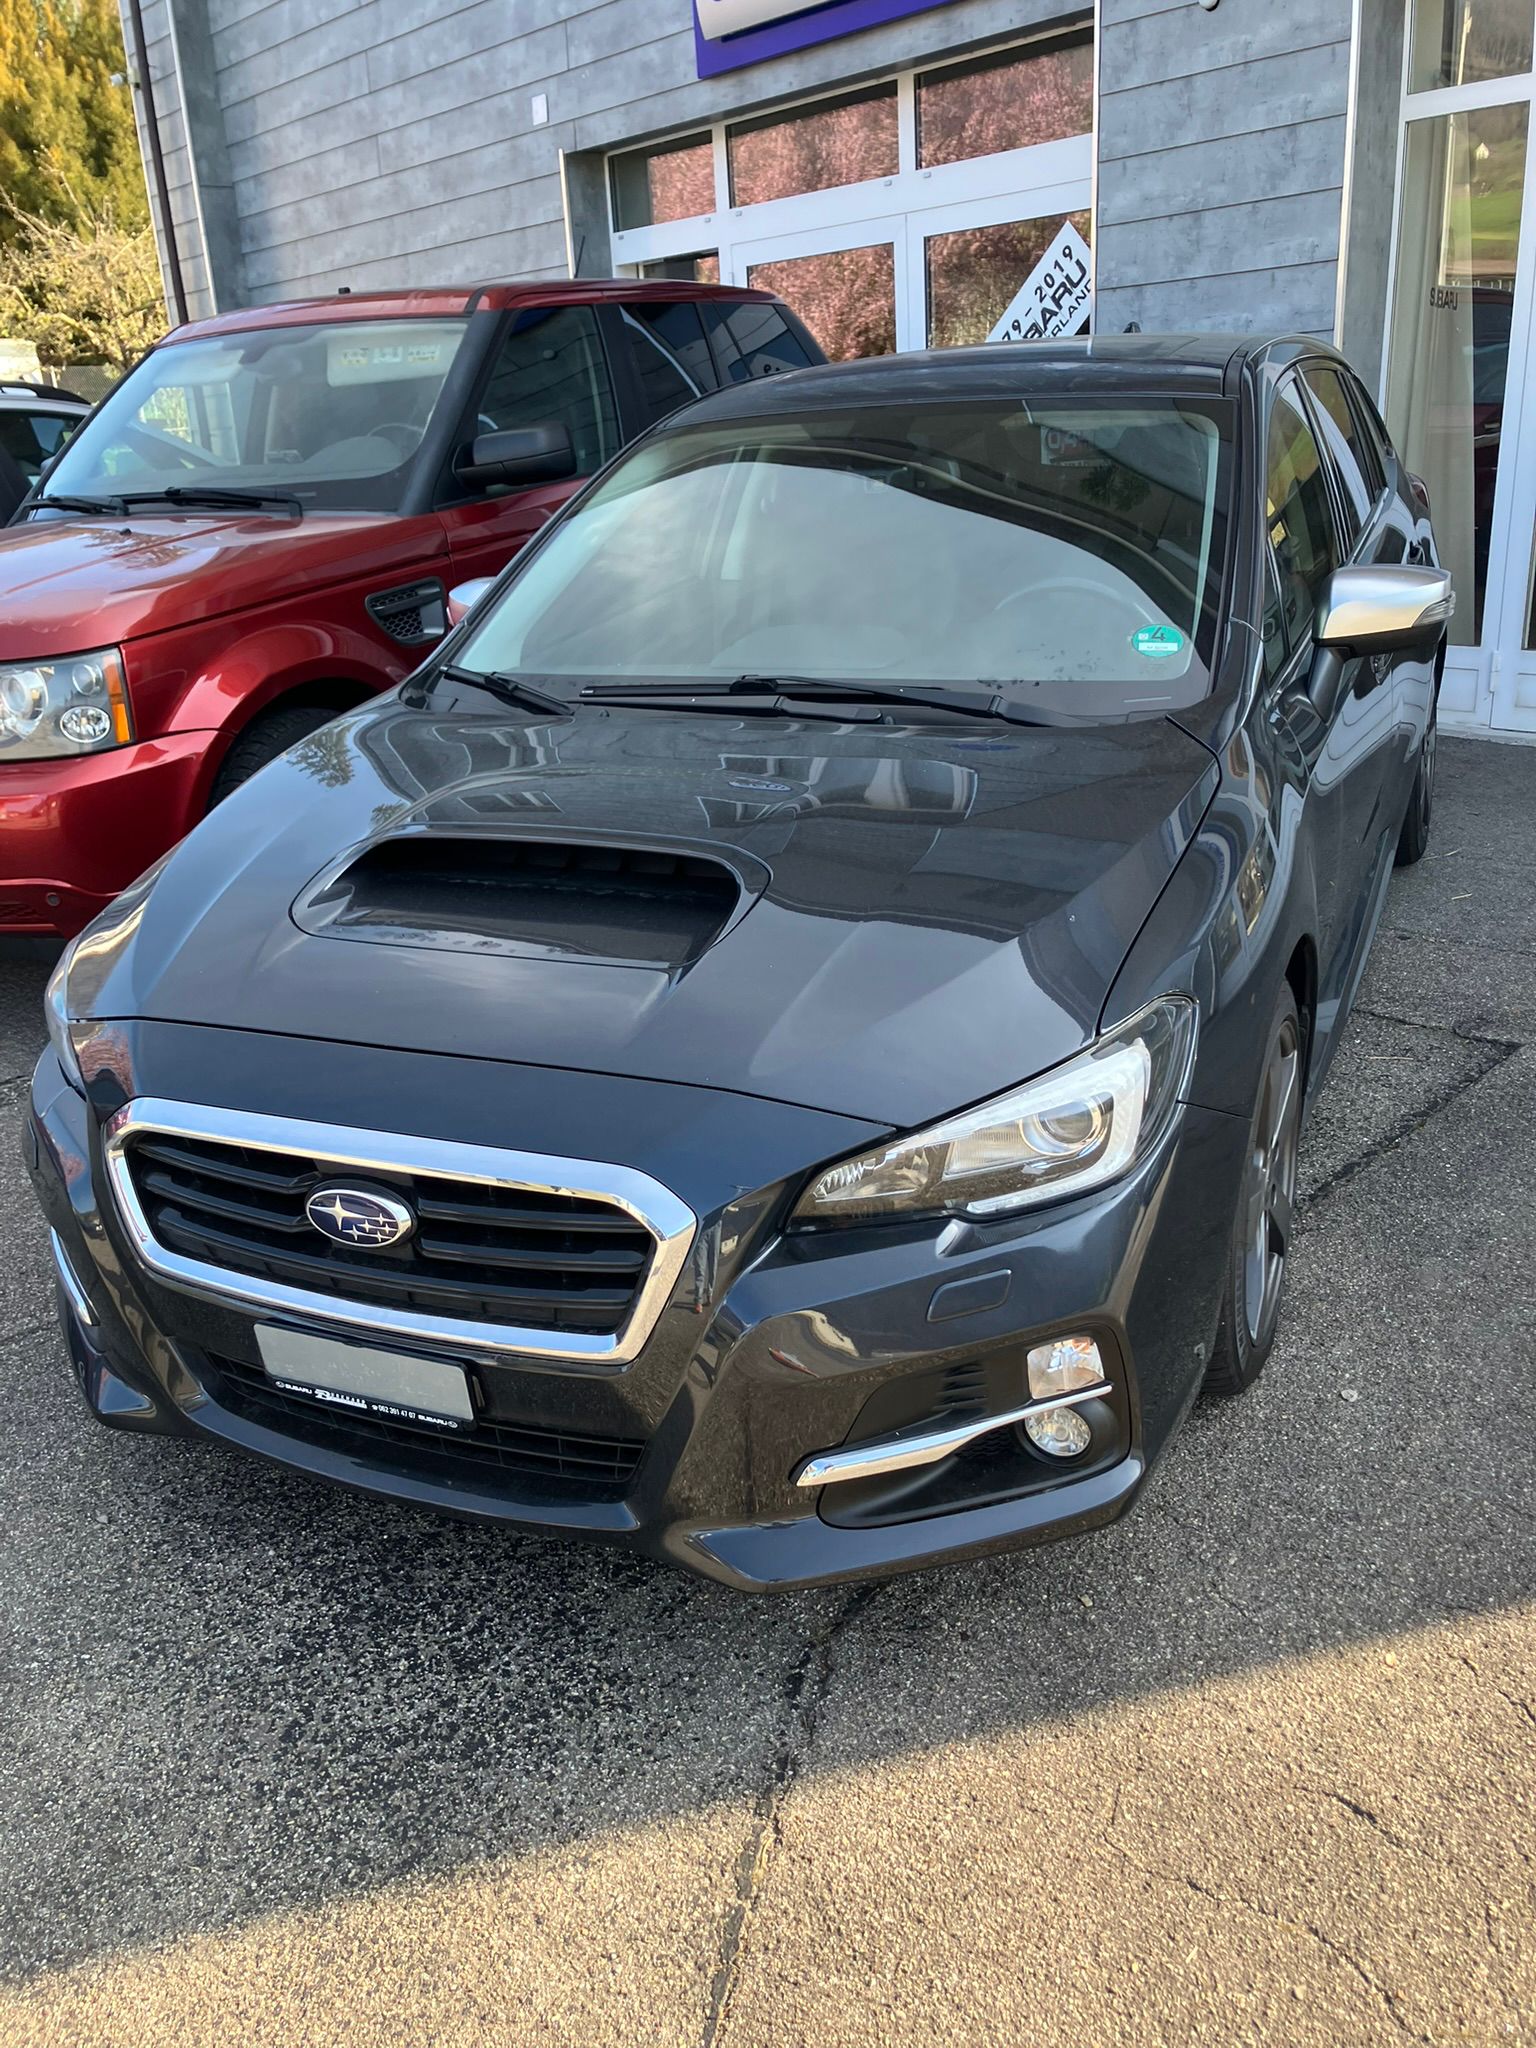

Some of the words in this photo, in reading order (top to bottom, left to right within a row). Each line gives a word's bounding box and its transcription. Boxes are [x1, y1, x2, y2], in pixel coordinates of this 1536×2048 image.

[1002, 319, 1022, 340] 79
[1034, 245, 1073, 303] 2019
[1023, 259, 1087, 339] BARU
[1151, 626, 1166, 641] 4
[284, 1383, 313, 1394] SUBARU
[417, 1414, 448, 1426] SUBARU
